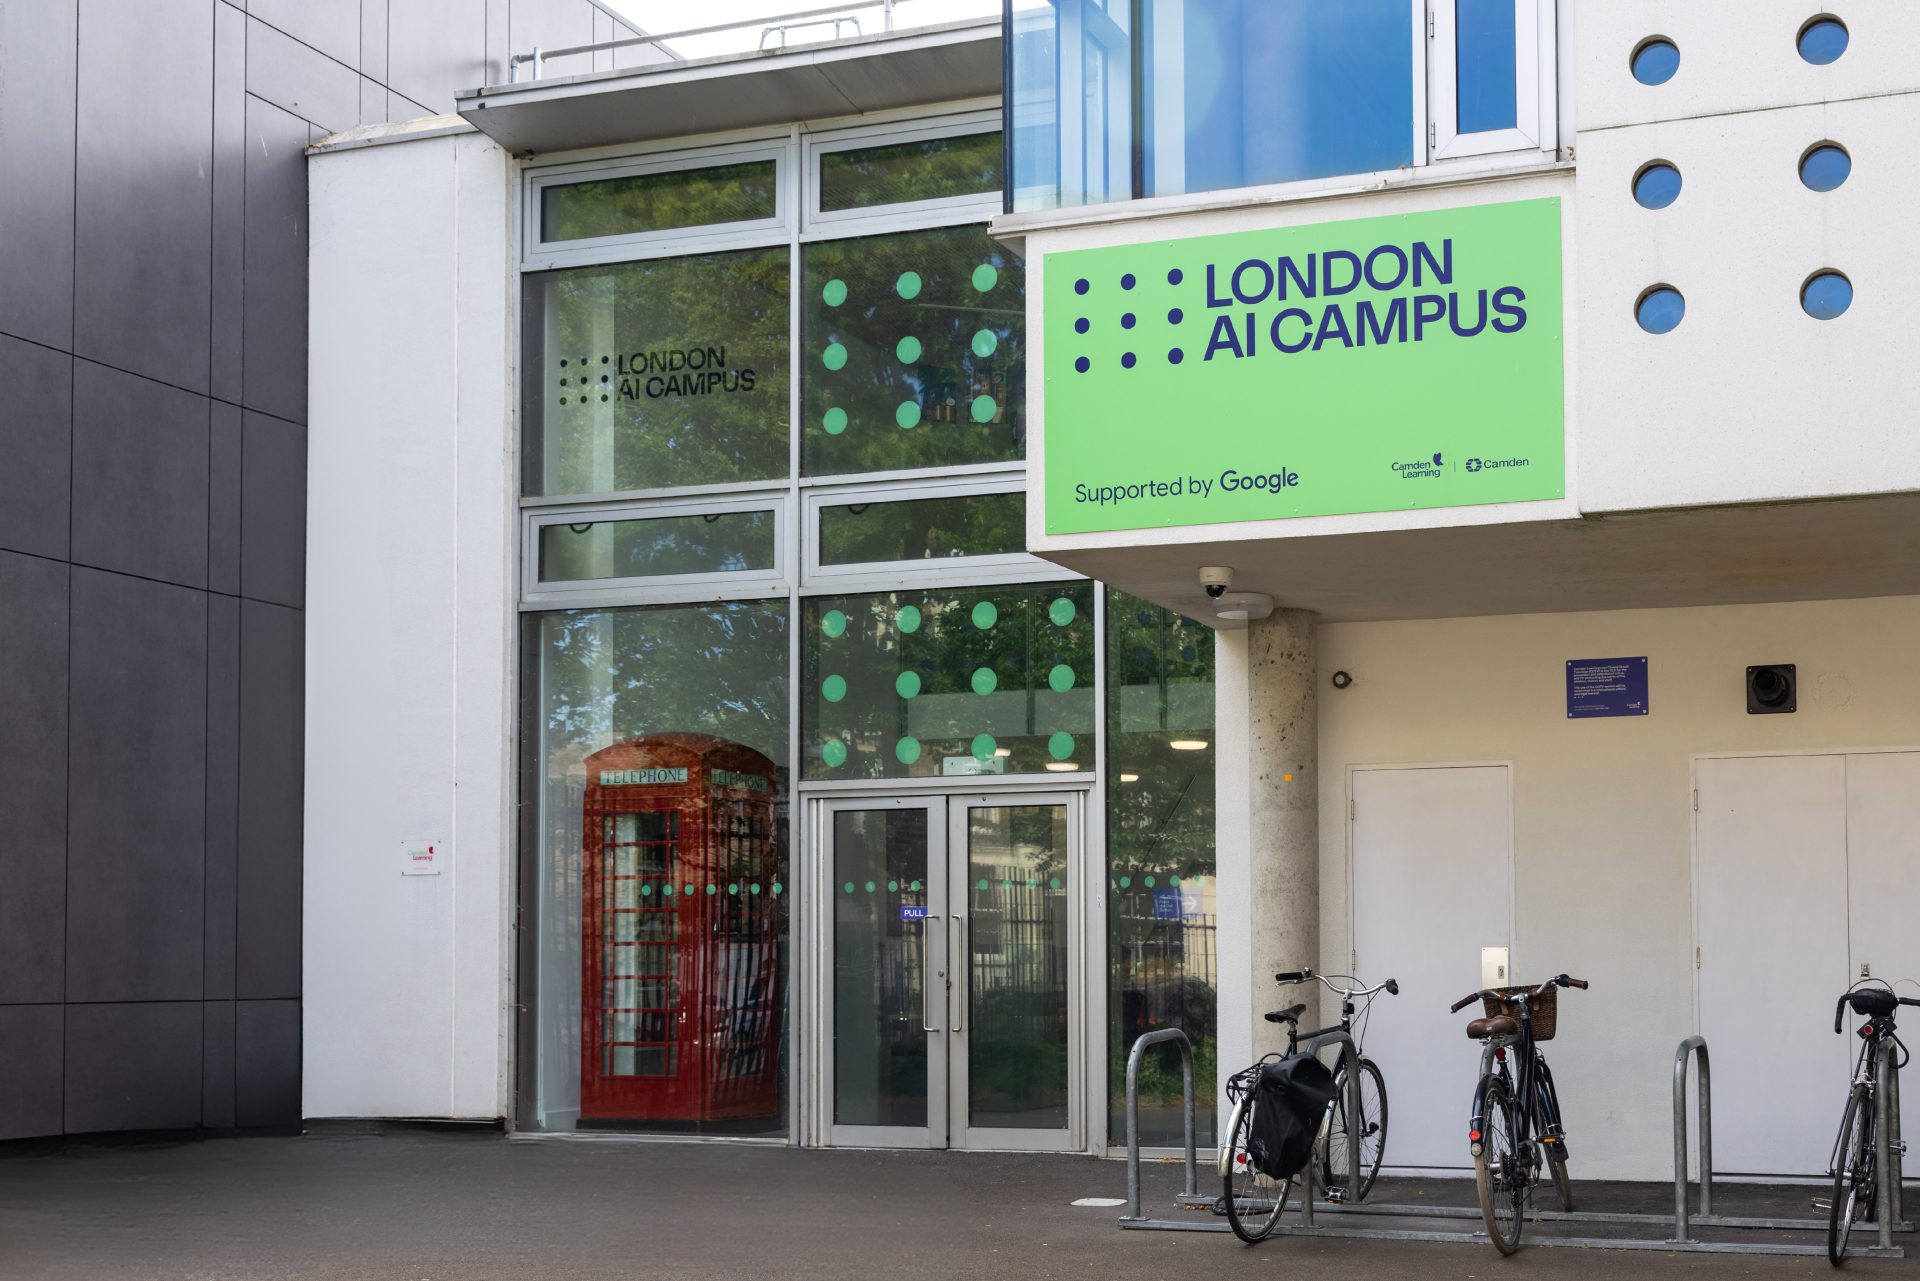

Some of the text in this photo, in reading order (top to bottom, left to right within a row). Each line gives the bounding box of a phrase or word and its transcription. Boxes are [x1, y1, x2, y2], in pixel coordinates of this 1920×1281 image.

[1206, 238, 1453, 309] LONDON
[1203, 285, 1528, 362] AI CAMPUS
[617, 346, 725, 375] LONDON
[617, 369, 756, 401] AI CAMPUS
[1391, 460, 1431, 471] Camden
[1402, 469, 1441, 479] Learning
[1483, 457, 1530, 469] Camden
[1075, 466, 1300, 506] Supported by Google
[605, 769, 686, 784] TELEPHONE
[904, 909, 924, 917] PULL
